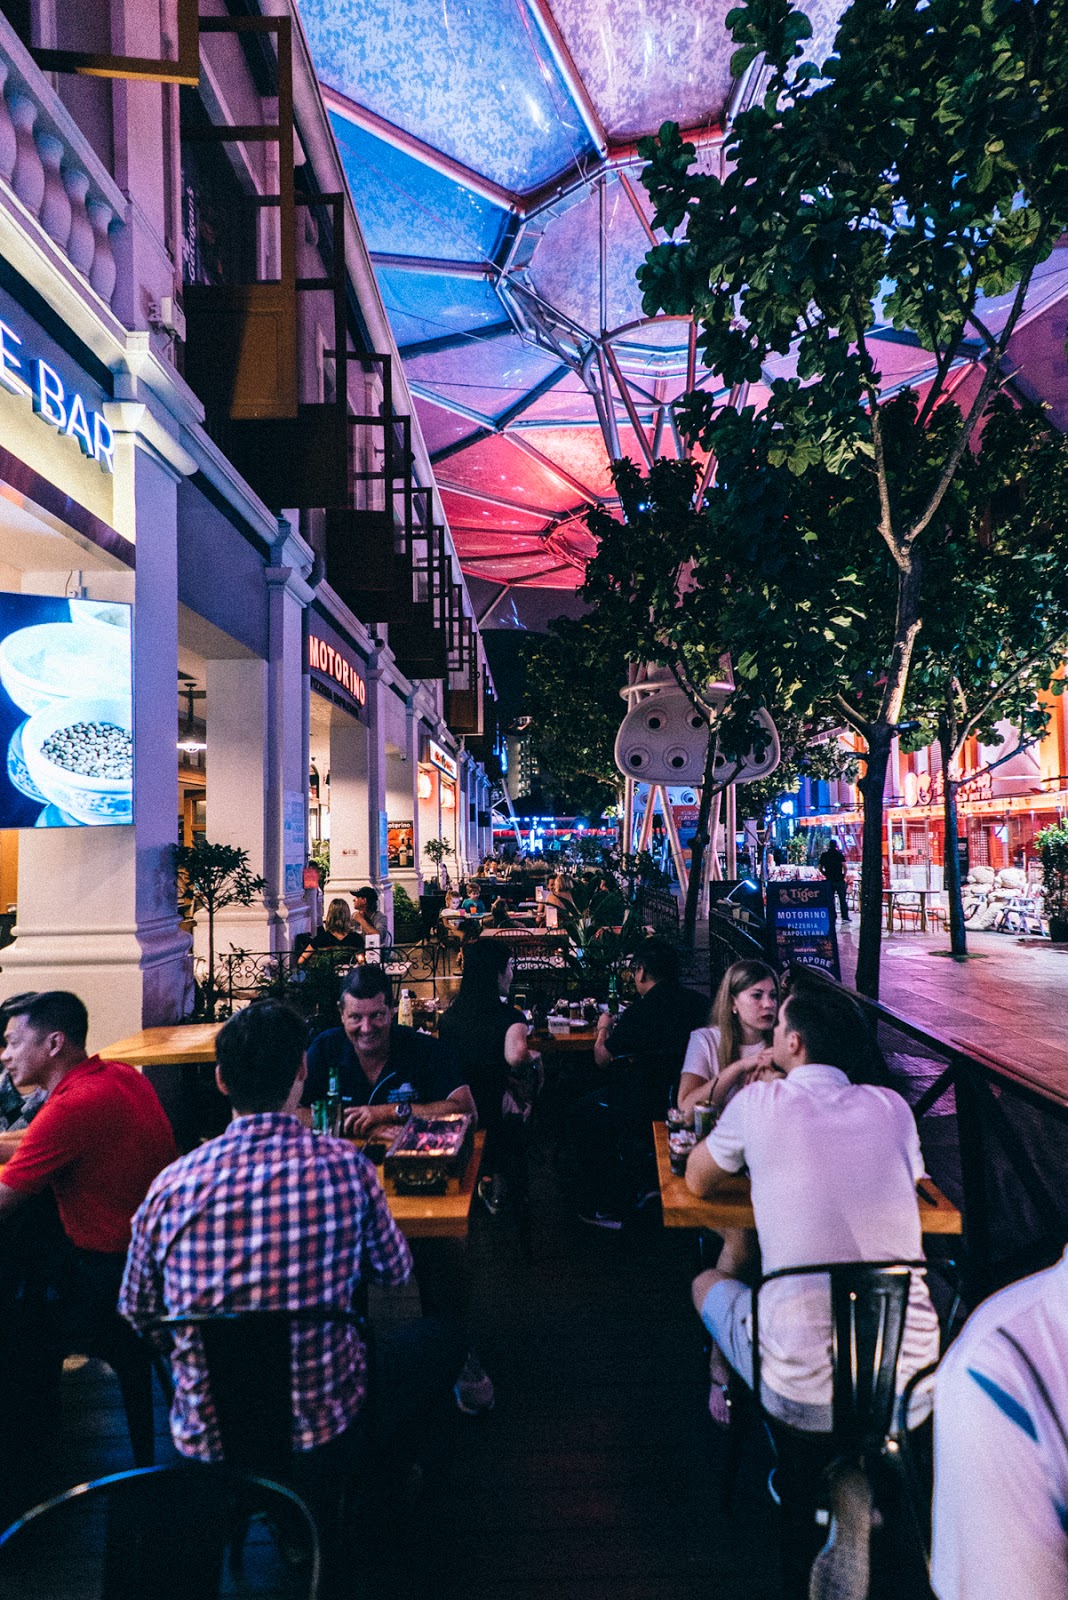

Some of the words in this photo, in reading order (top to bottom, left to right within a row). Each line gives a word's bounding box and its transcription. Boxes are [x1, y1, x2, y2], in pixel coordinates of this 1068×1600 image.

[38, 358, 114, 474] BAR
[308, 634, 366, 706] MOTORINO
[777, 911, 827, 919] MOTORINO
[790, 887, 820, 903] Tiger
